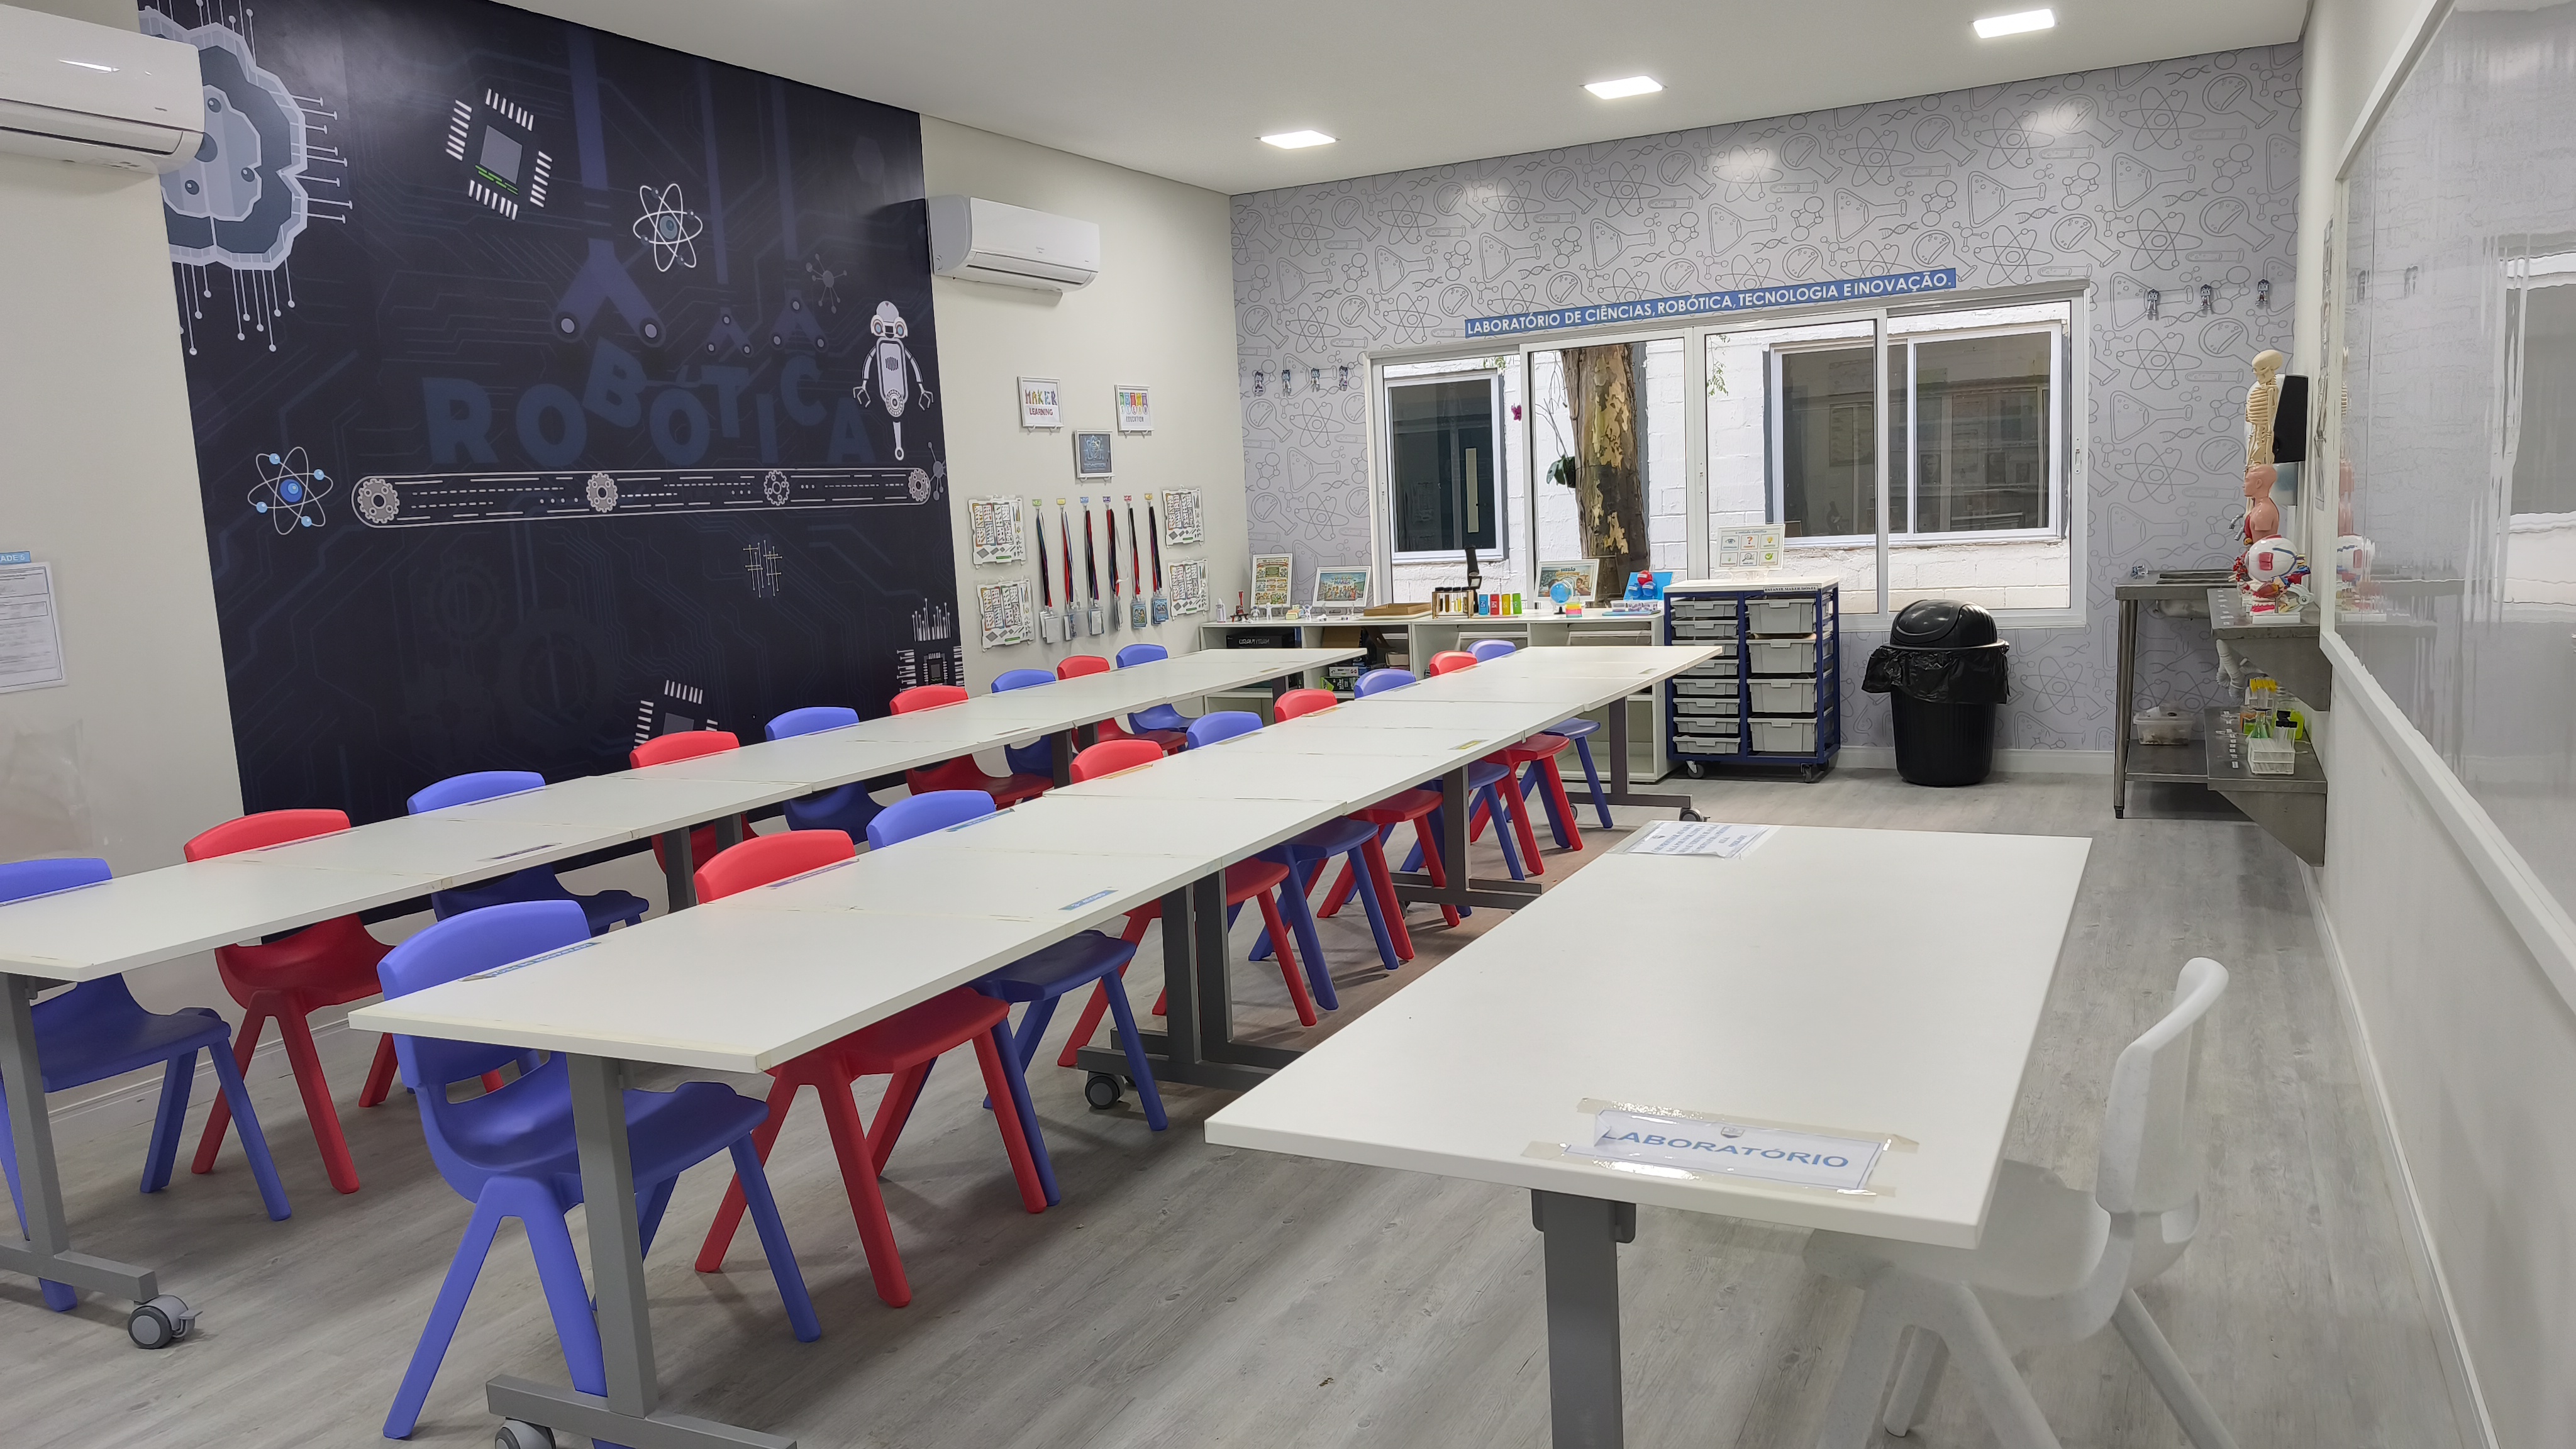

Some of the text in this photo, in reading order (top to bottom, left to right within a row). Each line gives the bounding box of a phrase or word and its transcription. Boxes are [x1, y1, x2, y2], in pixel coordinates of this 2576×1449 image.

[1467, 272, 1951, 335] LABORATÓRIO DE CIÊNCIAS, ROBÓTICA, TECNOLOGIA E INOVAÇÃO.
[1024, 388, 1057, 406] MAKER
[1029, 408, 1053, 416] LEARNING
[1601, 1130, 1850, 1169] LABORATÓRIO
